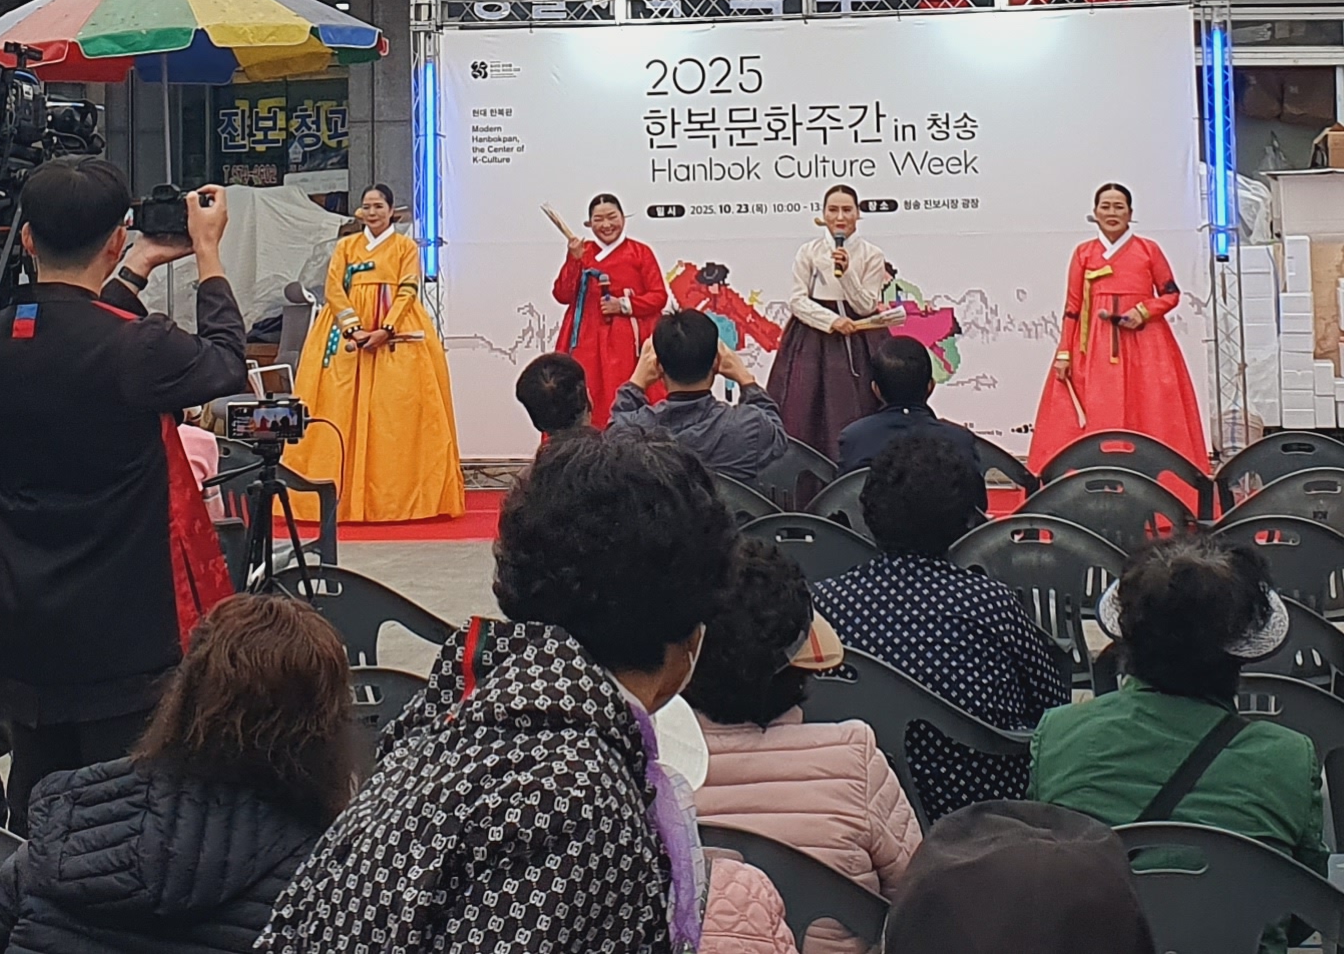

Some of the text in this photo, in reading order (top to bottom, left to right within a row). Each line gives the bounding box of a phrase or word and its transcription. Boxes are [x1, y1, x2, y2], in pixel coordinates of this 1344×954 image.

[645, 55, 764, 97] 2025
[472, 108, 513, 117] 현대 한복판
[472, 125, 502, 133] Modern
[643, 100, 979, 150] 한복문화주간 in 청송
[472, 135, 520, 144] Hanbokpan,
[472, 155, 511, 163] K-Culture
[650, 149, 980, 183] Hanbok Culture Week
[772, 202, 801, 214] 10:00
[904, 198, 980, 210] 청송 진보시장 광장
